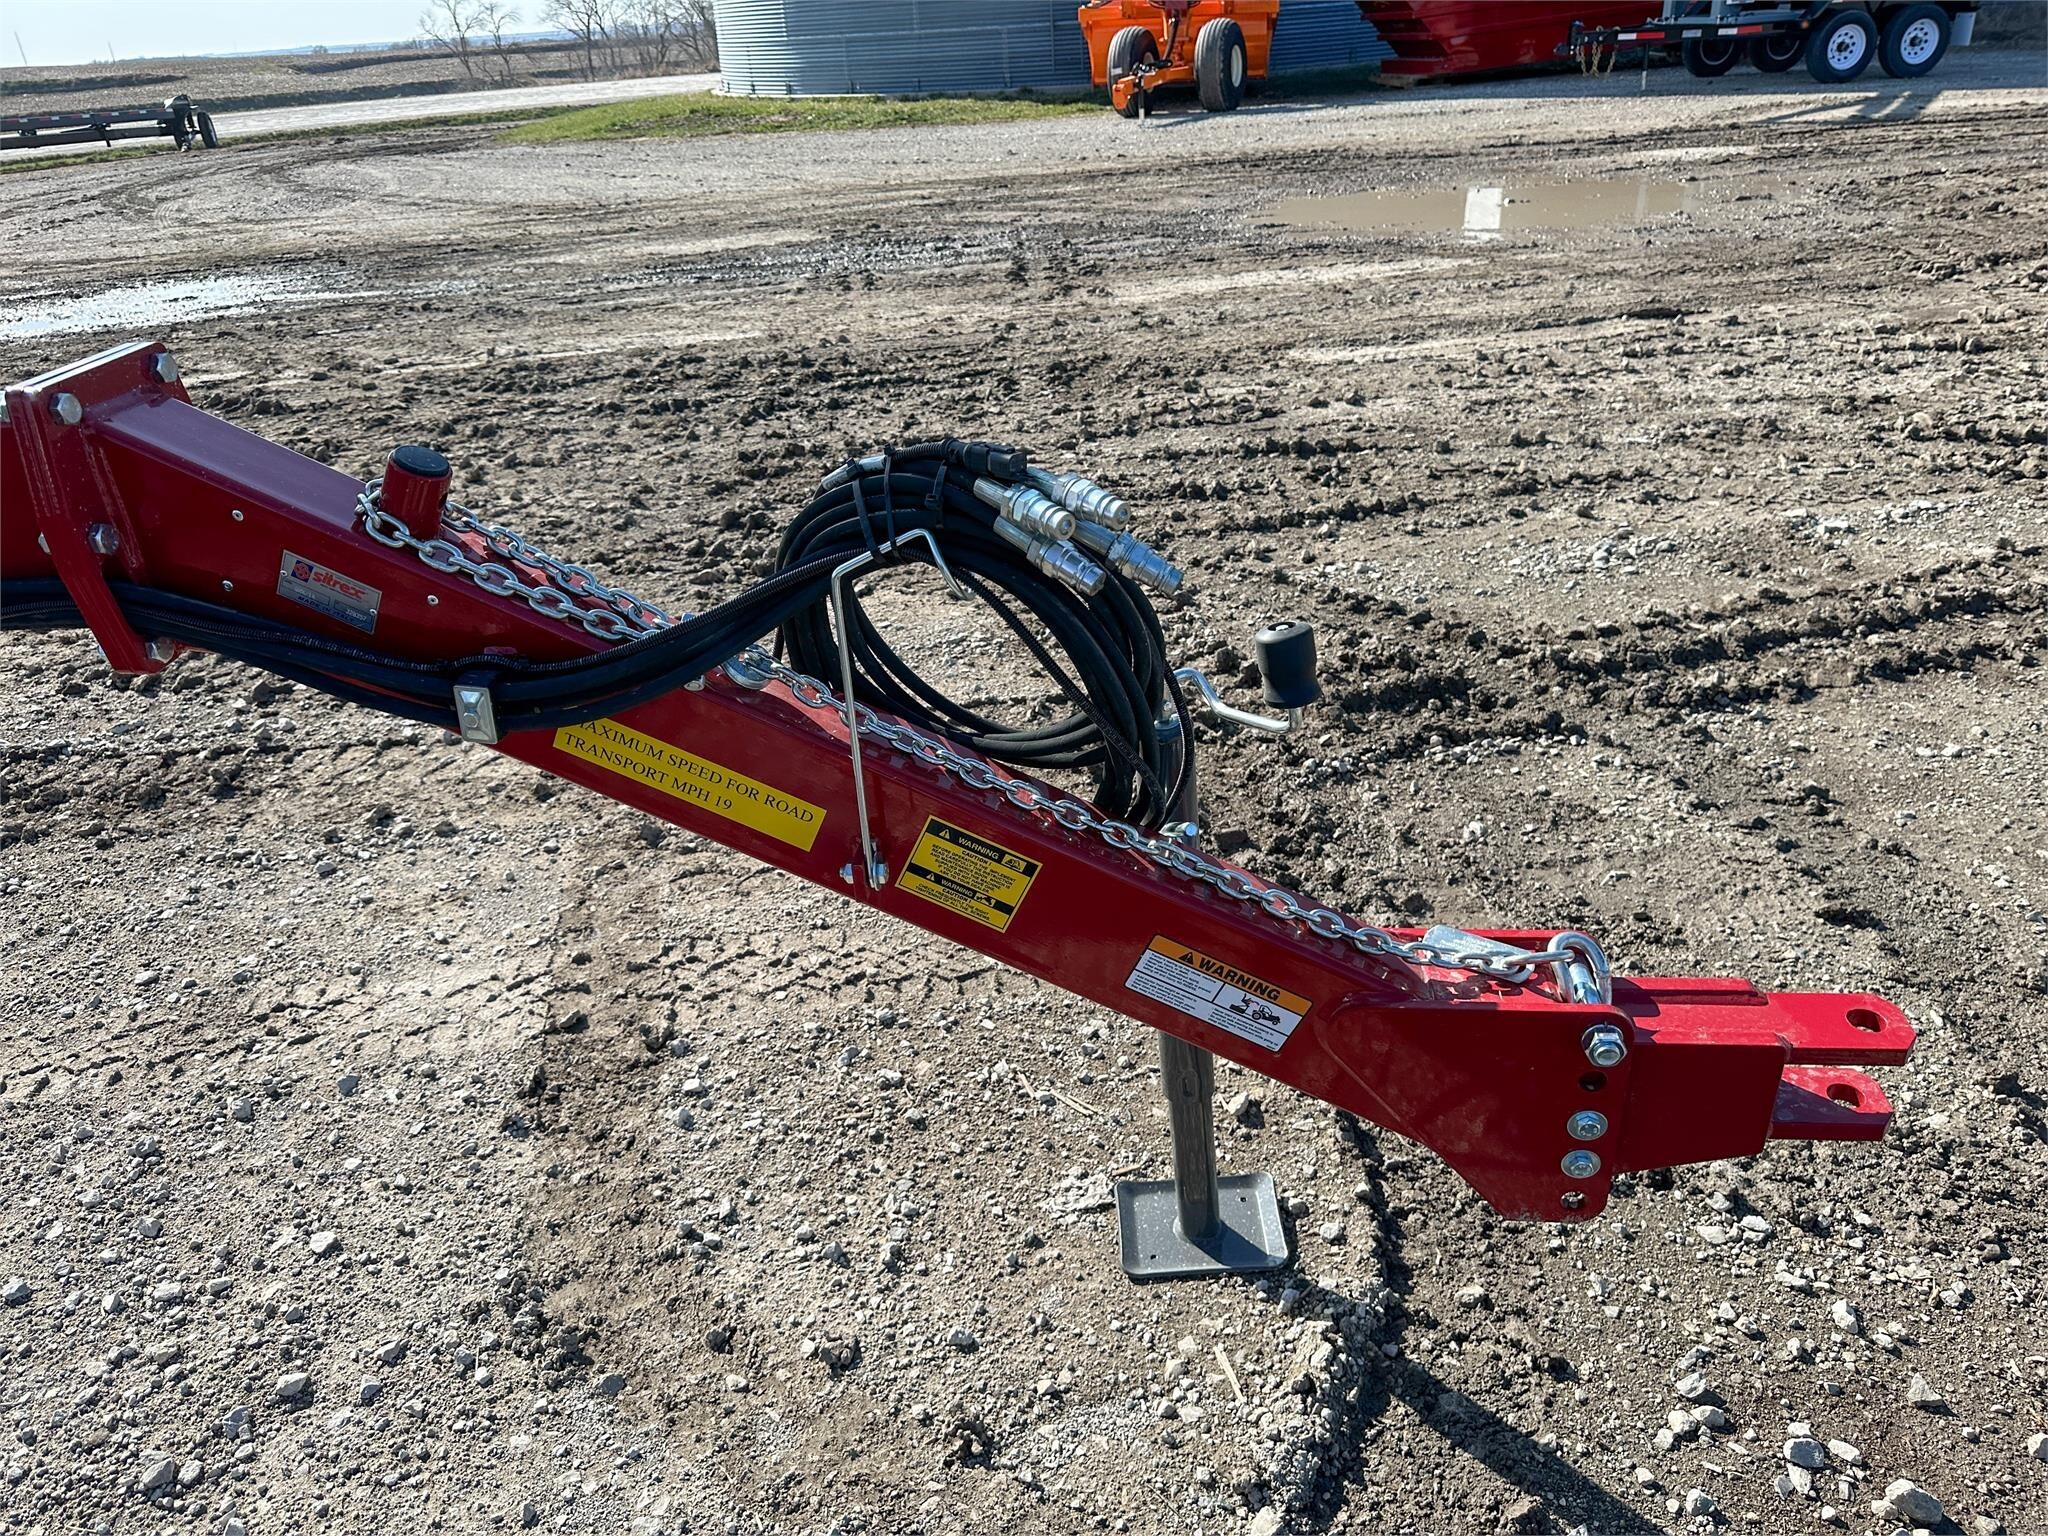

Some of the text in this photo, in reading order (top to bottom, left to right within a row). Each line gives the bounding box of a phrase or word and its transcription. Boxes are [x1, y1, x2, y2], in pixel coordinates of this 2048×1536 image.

[313, 571, 368, 599] sitrex
[565, 732, 733, 810] TRANSPORT MPH 19
[579, 721, 814, 823] AXIMUM SPEED FOR ROAD
[958, 837, 999, 859] WARNING
[961, 850, 988, 864] CAUTION
[941, 879, 974, 897] WARNING
[941, 888, 968, 902] CAUTION
[1198, 958, 1281, 1001] WARNING
